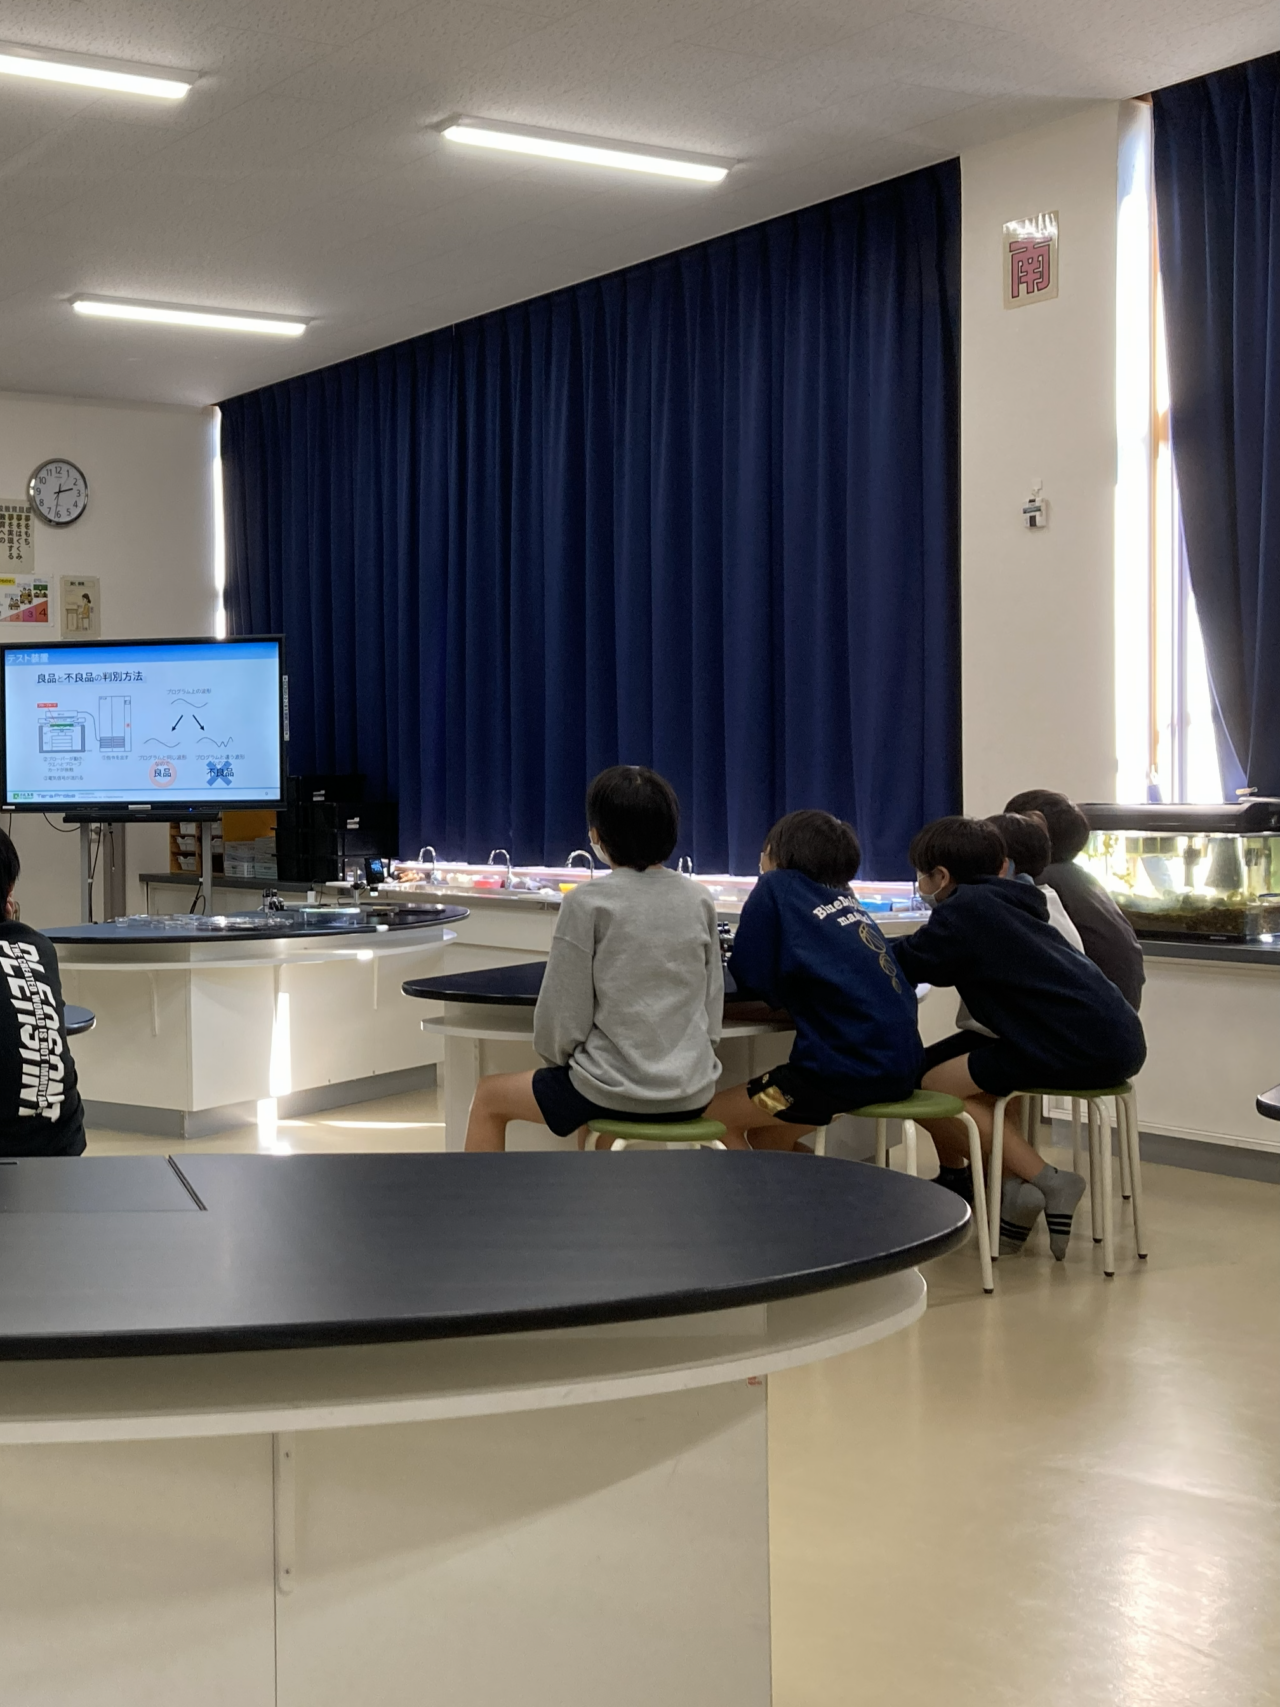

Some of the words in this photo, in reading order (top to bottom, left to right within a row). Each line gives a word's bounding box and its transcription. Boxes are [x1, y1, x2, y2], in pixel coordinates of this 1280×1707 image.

[1009, 236, 1051, 299] 南
[55, 466, 62, 474] 12
[67, 469, 70, 477] 1
[39, 476, 46, 485] 10
[73, 478, 78, 486] 2
[36, 487, 41, 495] 9
[76, 489, 81, 497] 3
[39, 499, 44, 507] 8
[47, 507, 51, 515] 7
[57, 510, 61, 518] 6
[66, 508, 71, 516] 5
[27, 610, 33, 618] 3
[39, 608, 47, 617] 4
[7, 653, 49, 664] テスト装置
[37, 670, 143, 684] 良品と不良品の判別方法
[154, 768, 172, 777] 良品
[206, 767, 234, 777] 不良品
[10, 944, 21, 959] THE
[18, 958, 38, 992] CREATED
[31, 994, 46, 1026] WORLD
[38, 1028, 48, 1038] IS
[40, 1041, 50, 1060] NOT
